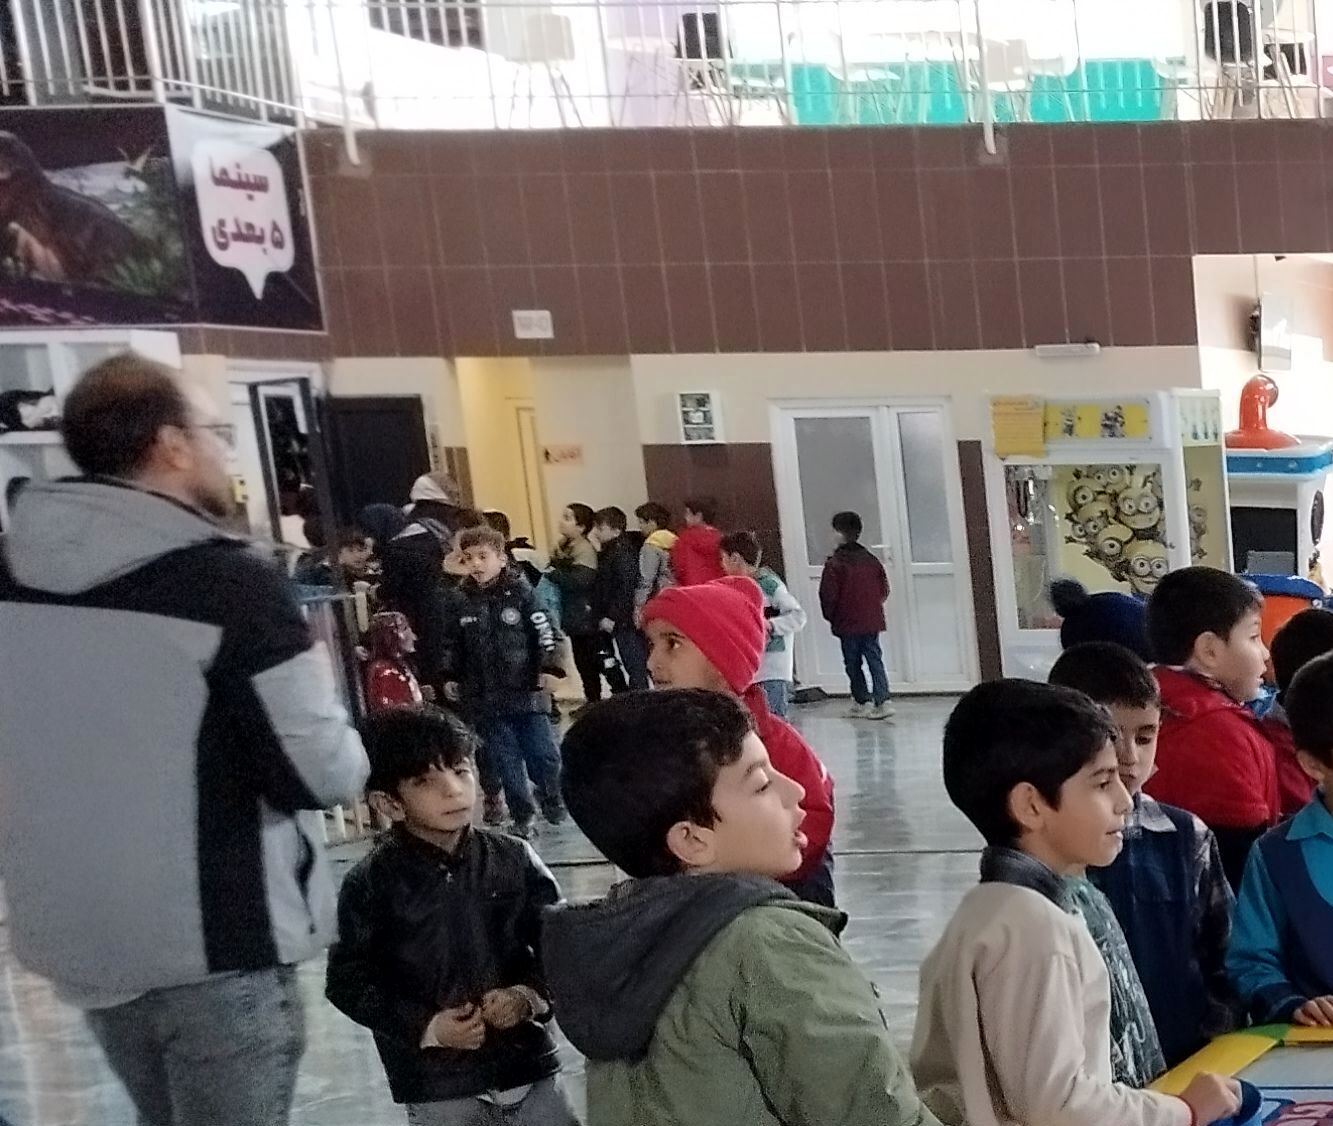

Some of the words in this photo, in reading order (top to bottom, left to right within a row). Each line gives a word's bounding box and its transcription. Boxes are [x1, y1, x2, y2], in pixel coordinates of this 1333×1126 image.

[208, 157, 269, 201] سینما
[211, 217, 268, 255] بعدی
[271, 219, 285, 250] ۵
